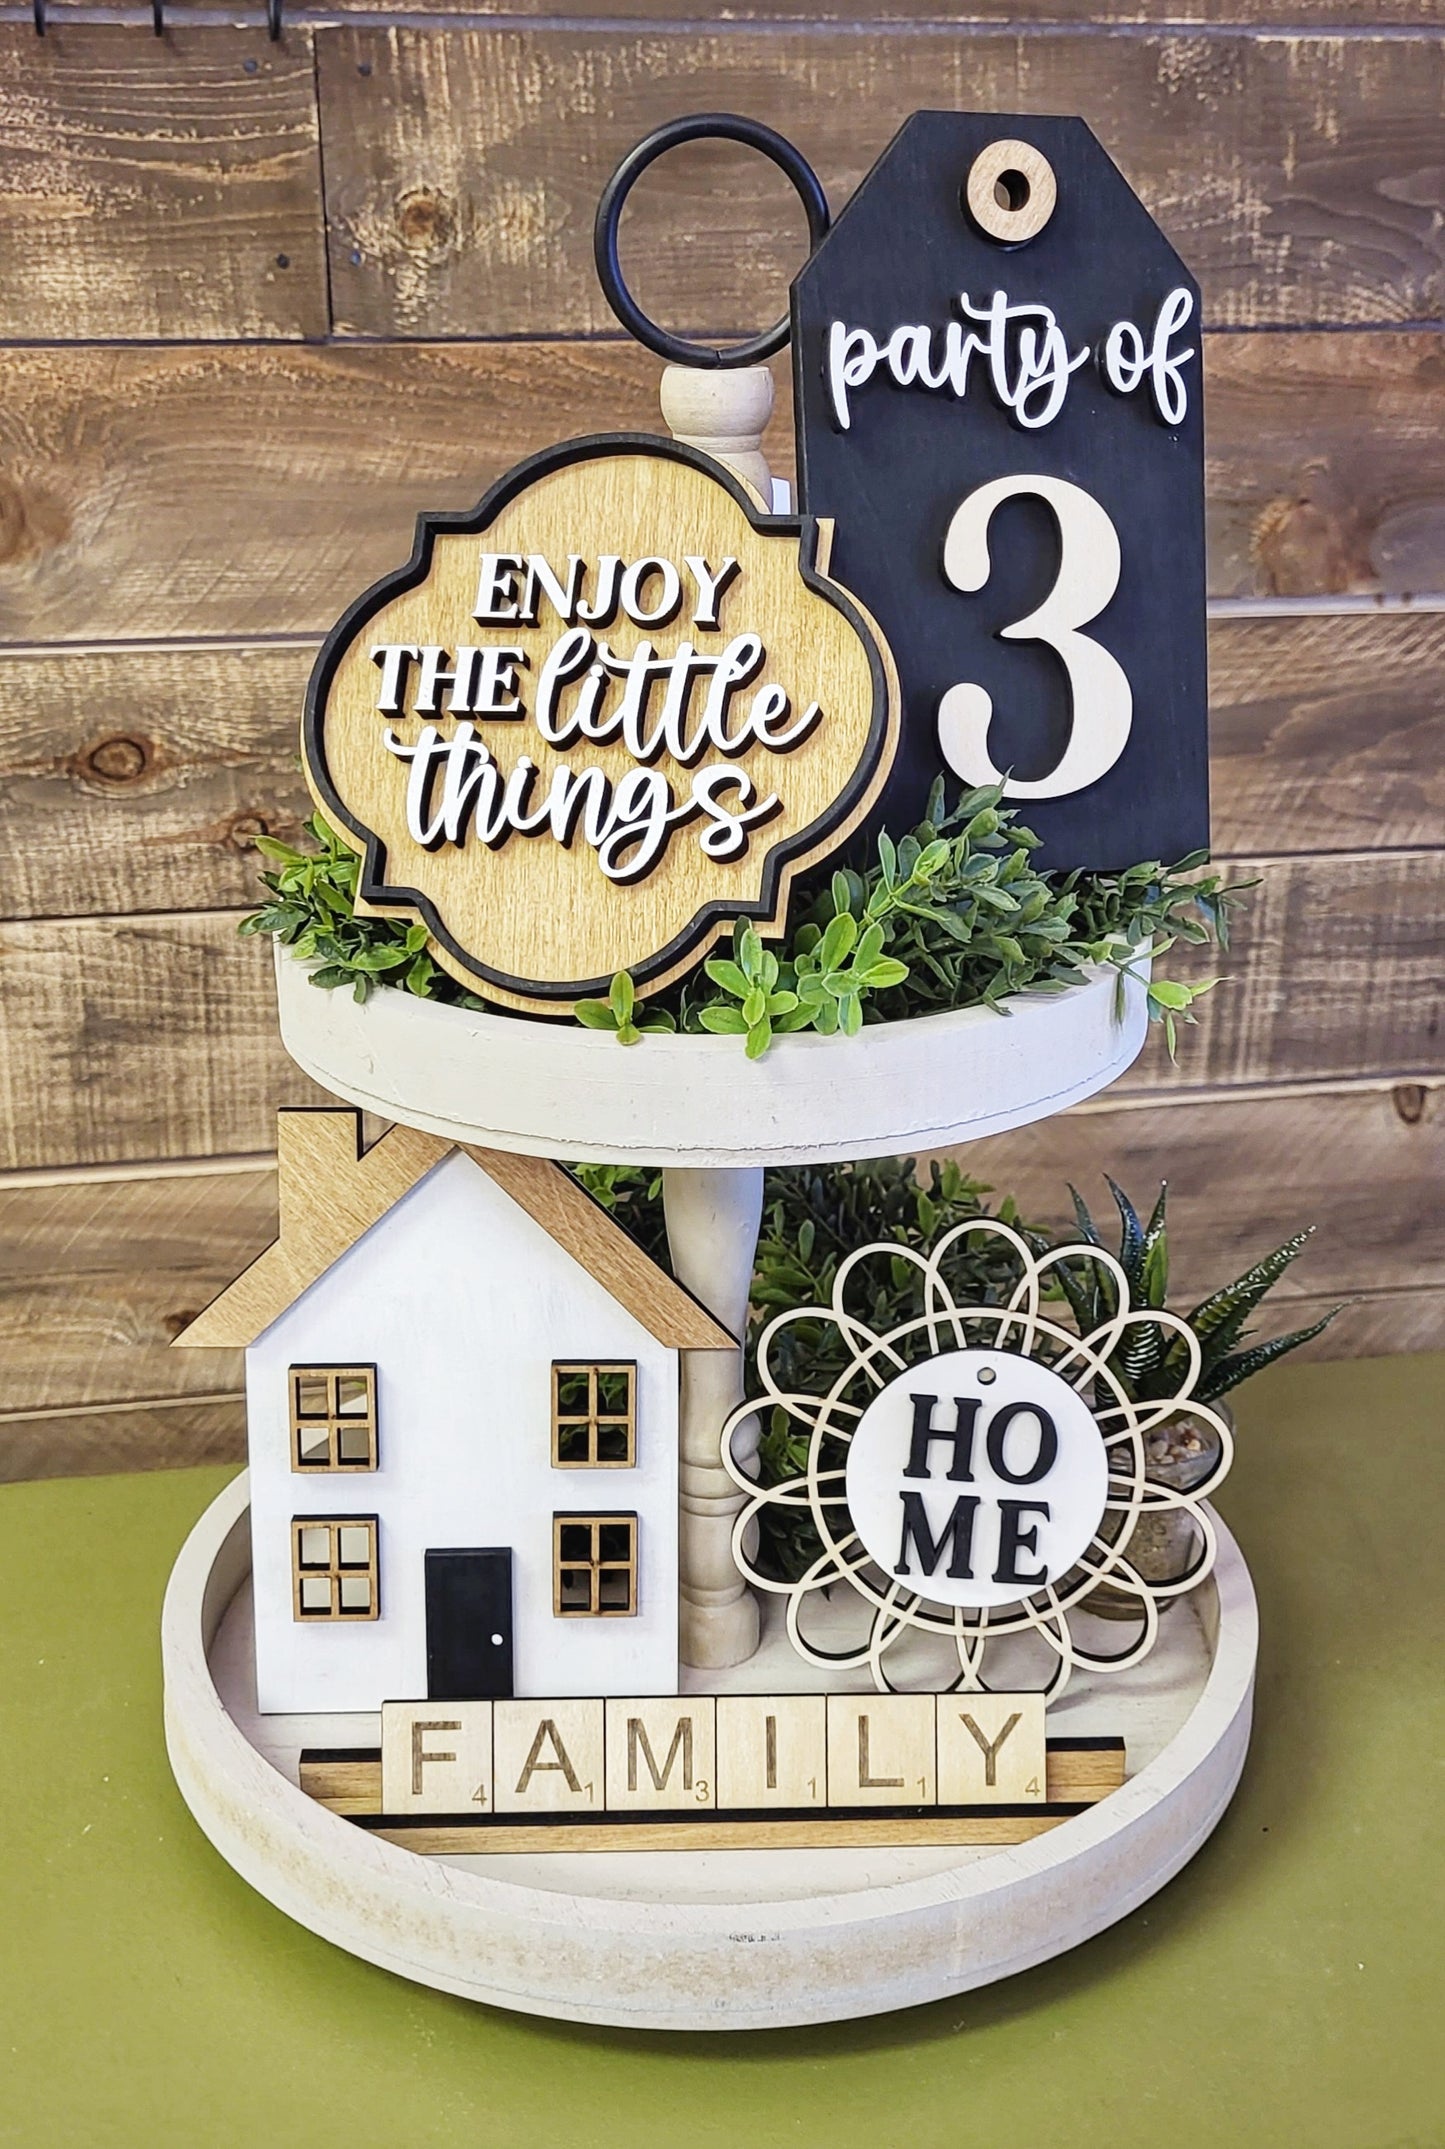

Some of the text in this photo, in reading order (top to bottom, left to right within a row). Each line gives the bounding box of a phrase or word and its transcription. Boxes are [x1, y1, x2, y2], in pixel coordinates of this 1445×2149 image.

[829, 287, 1195, 430] party of
[472, 552, 740, 626] ENJOY
[937, 473, 1134, 801] 3
[369, 626, 819, 763] THE little
[383, 720, 780, 881] things
[902, 1392, 1059, 1486] HO
[893, 1490, 1051, 1586] ME
[411, 1712, 1024, 1796] FAMILY
[583, 1781, 595, 1804] 1
[694, 1779, 711, 1803] 3
[806, 1776, 817, 1800] 1
[915, 1775, 927, 1799] 1
[1024, 1775, 1042, 1798] 4
[471, 1783, 488, 1807] 4
